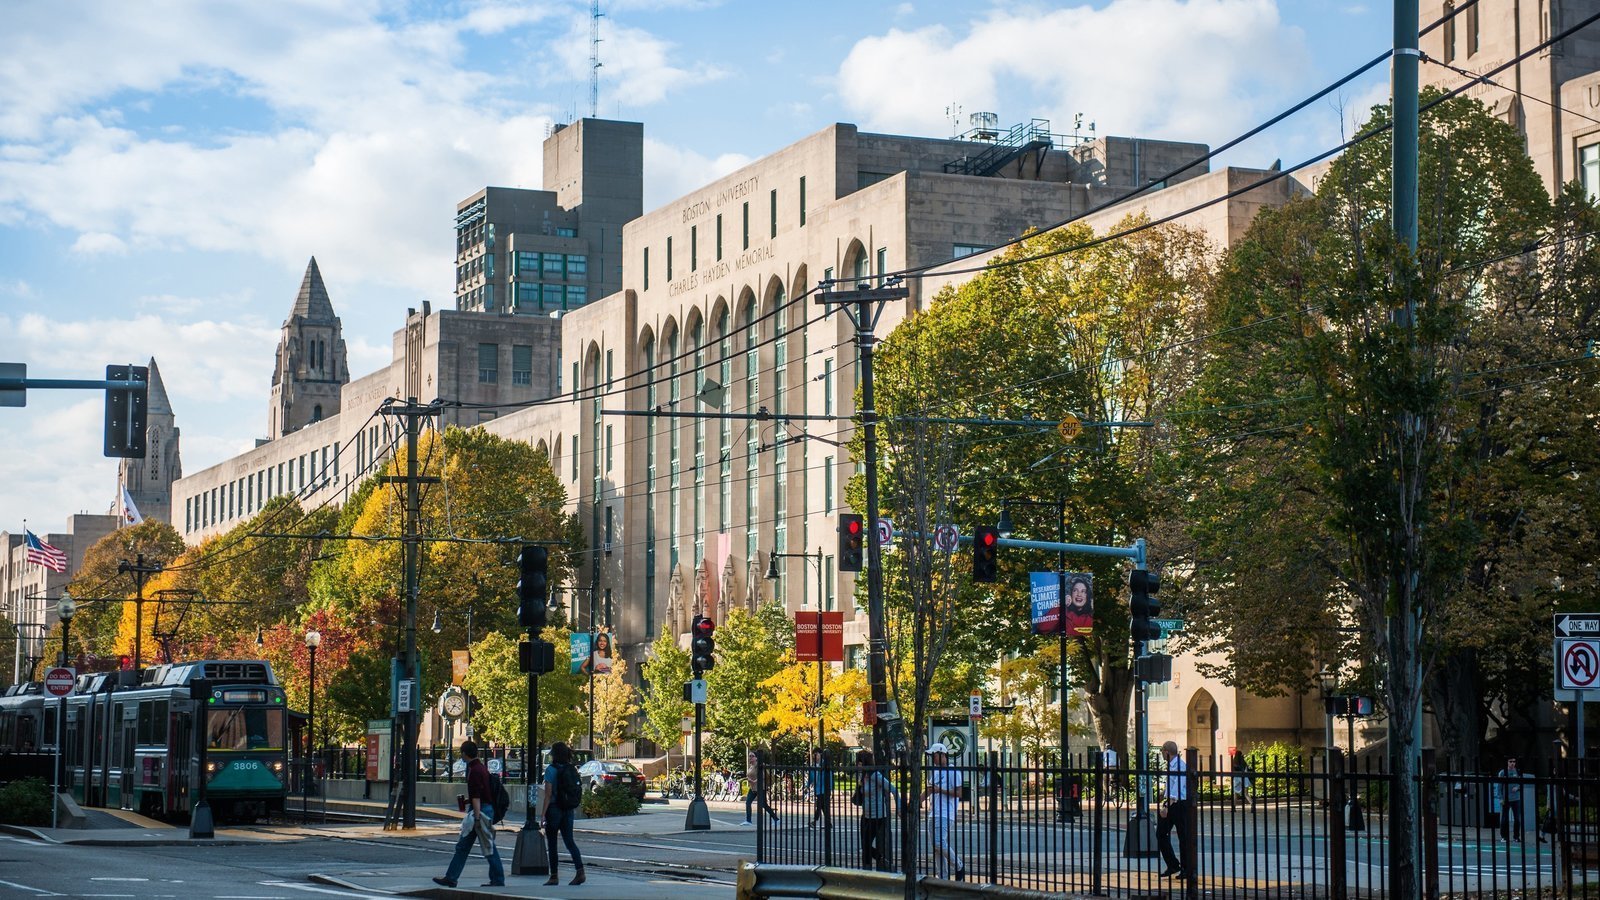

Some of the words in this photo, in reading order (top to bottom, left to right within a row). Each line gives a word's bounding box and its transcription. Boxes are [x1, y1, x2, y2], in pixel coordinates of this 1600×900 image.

[682, 198, 711, 223] BOSTON
[716, 176, 760, 208] UNIVERSITY
[669, 273, 699, 297] CHARLES
[702, 261, 731, 285] HAYDEN
[735, 242, 775, 272] MEMORIAL
[1031, 591, 1057, 603] CLIMATE
[1157, 621, 1177, 629] RANBY
[1569, 621, 1582, 630] ONE
[1584, 621, 1598, 630] WAY
[233, 762, 258, 770] 3806
